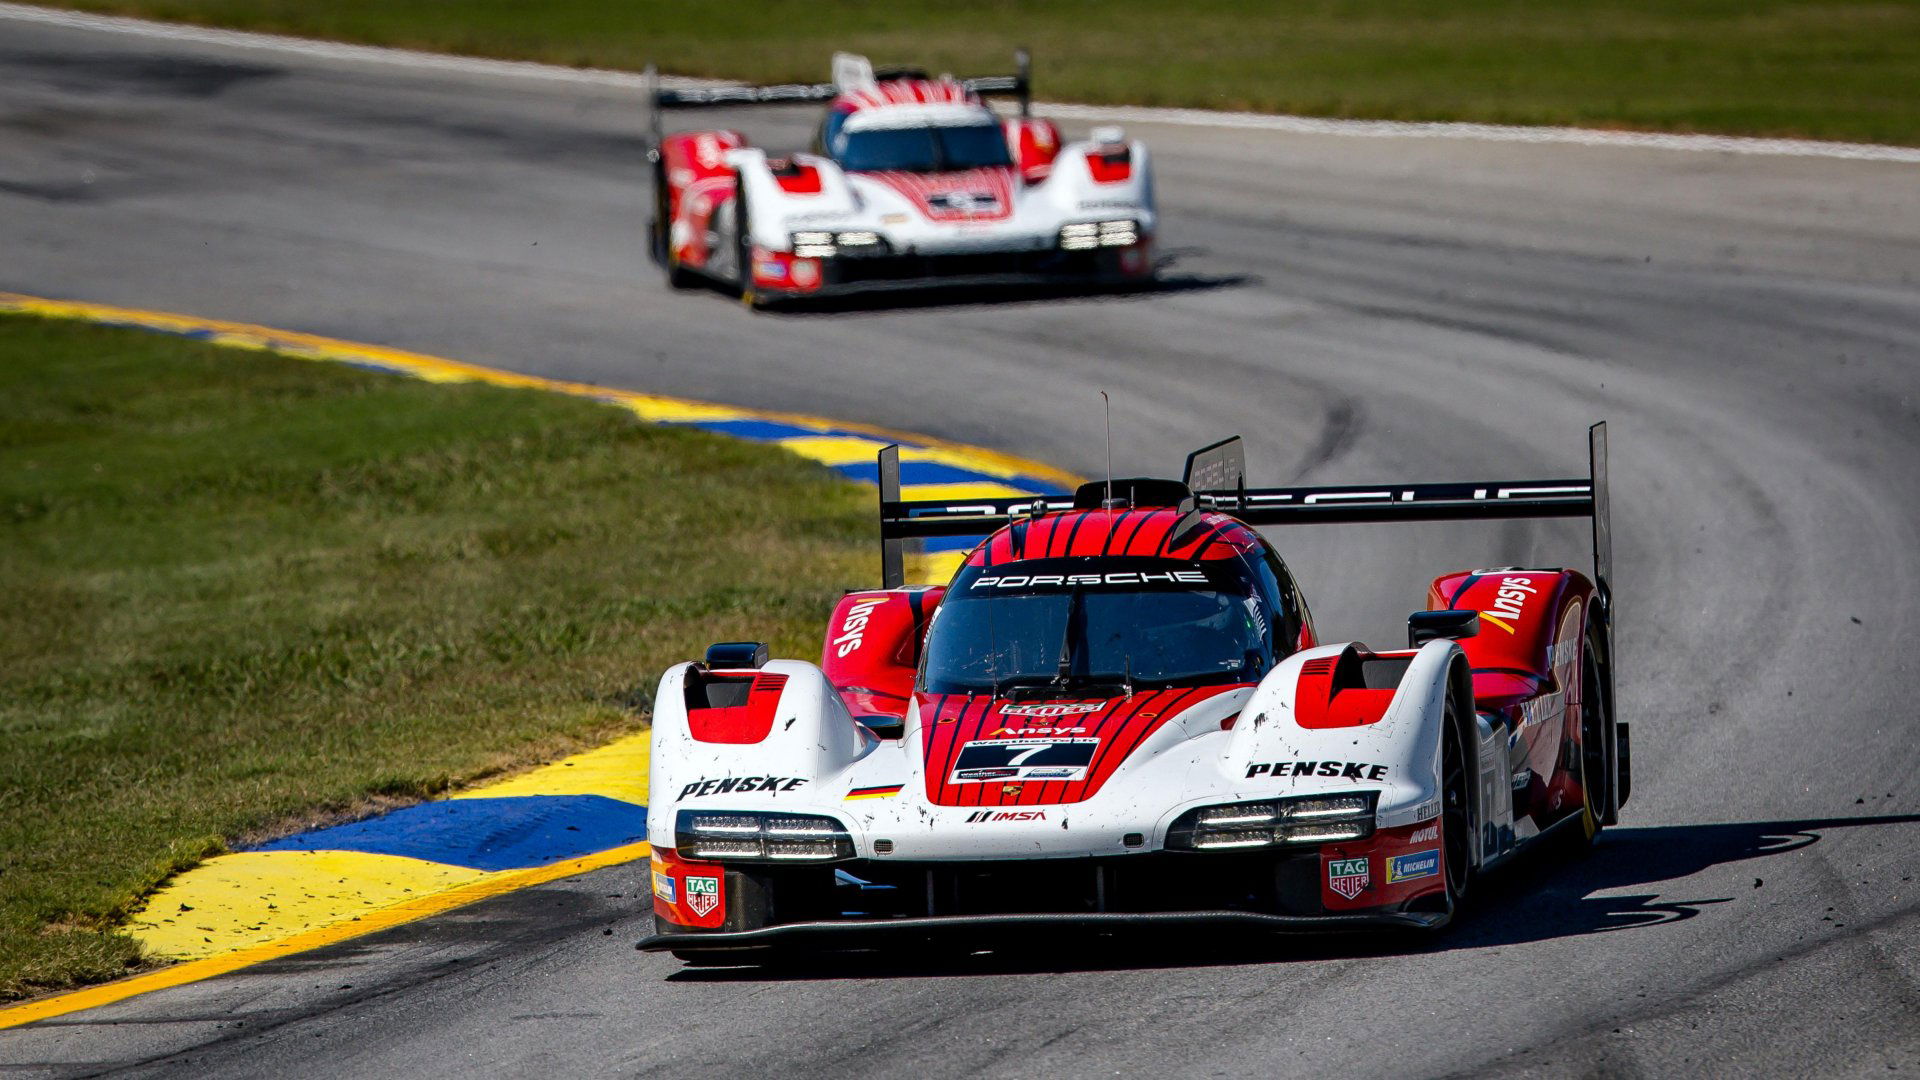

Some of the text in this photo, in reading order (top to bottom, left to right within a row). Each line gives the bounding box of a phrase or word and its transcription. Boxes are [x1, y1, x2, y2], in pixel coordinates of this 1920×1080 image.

[970, 571, 1209, 590] PORSCHE
[1479, 577, 1537, 635] Ansys
[833, 597, 890, 658] Ansys
[989, 727, 1086, 736] Ansys
[1005, 744, 1053, 766] 7
[1245, 761, 1389, 782] PENSKE
[675, 777, 810, 802] PENSKE
[992, 811, 1046, 822] IMSA
[1409, 826, 1439, 844] MOTUL
[1333, 861, 1366, 875] TAG
[1404, 859, 1435, 873] MICHELIN
[688, 879, 715, 893] TAG
[1332, 875, 1367, 896] HEUER
[688, 893, 716, 914] HEUER
